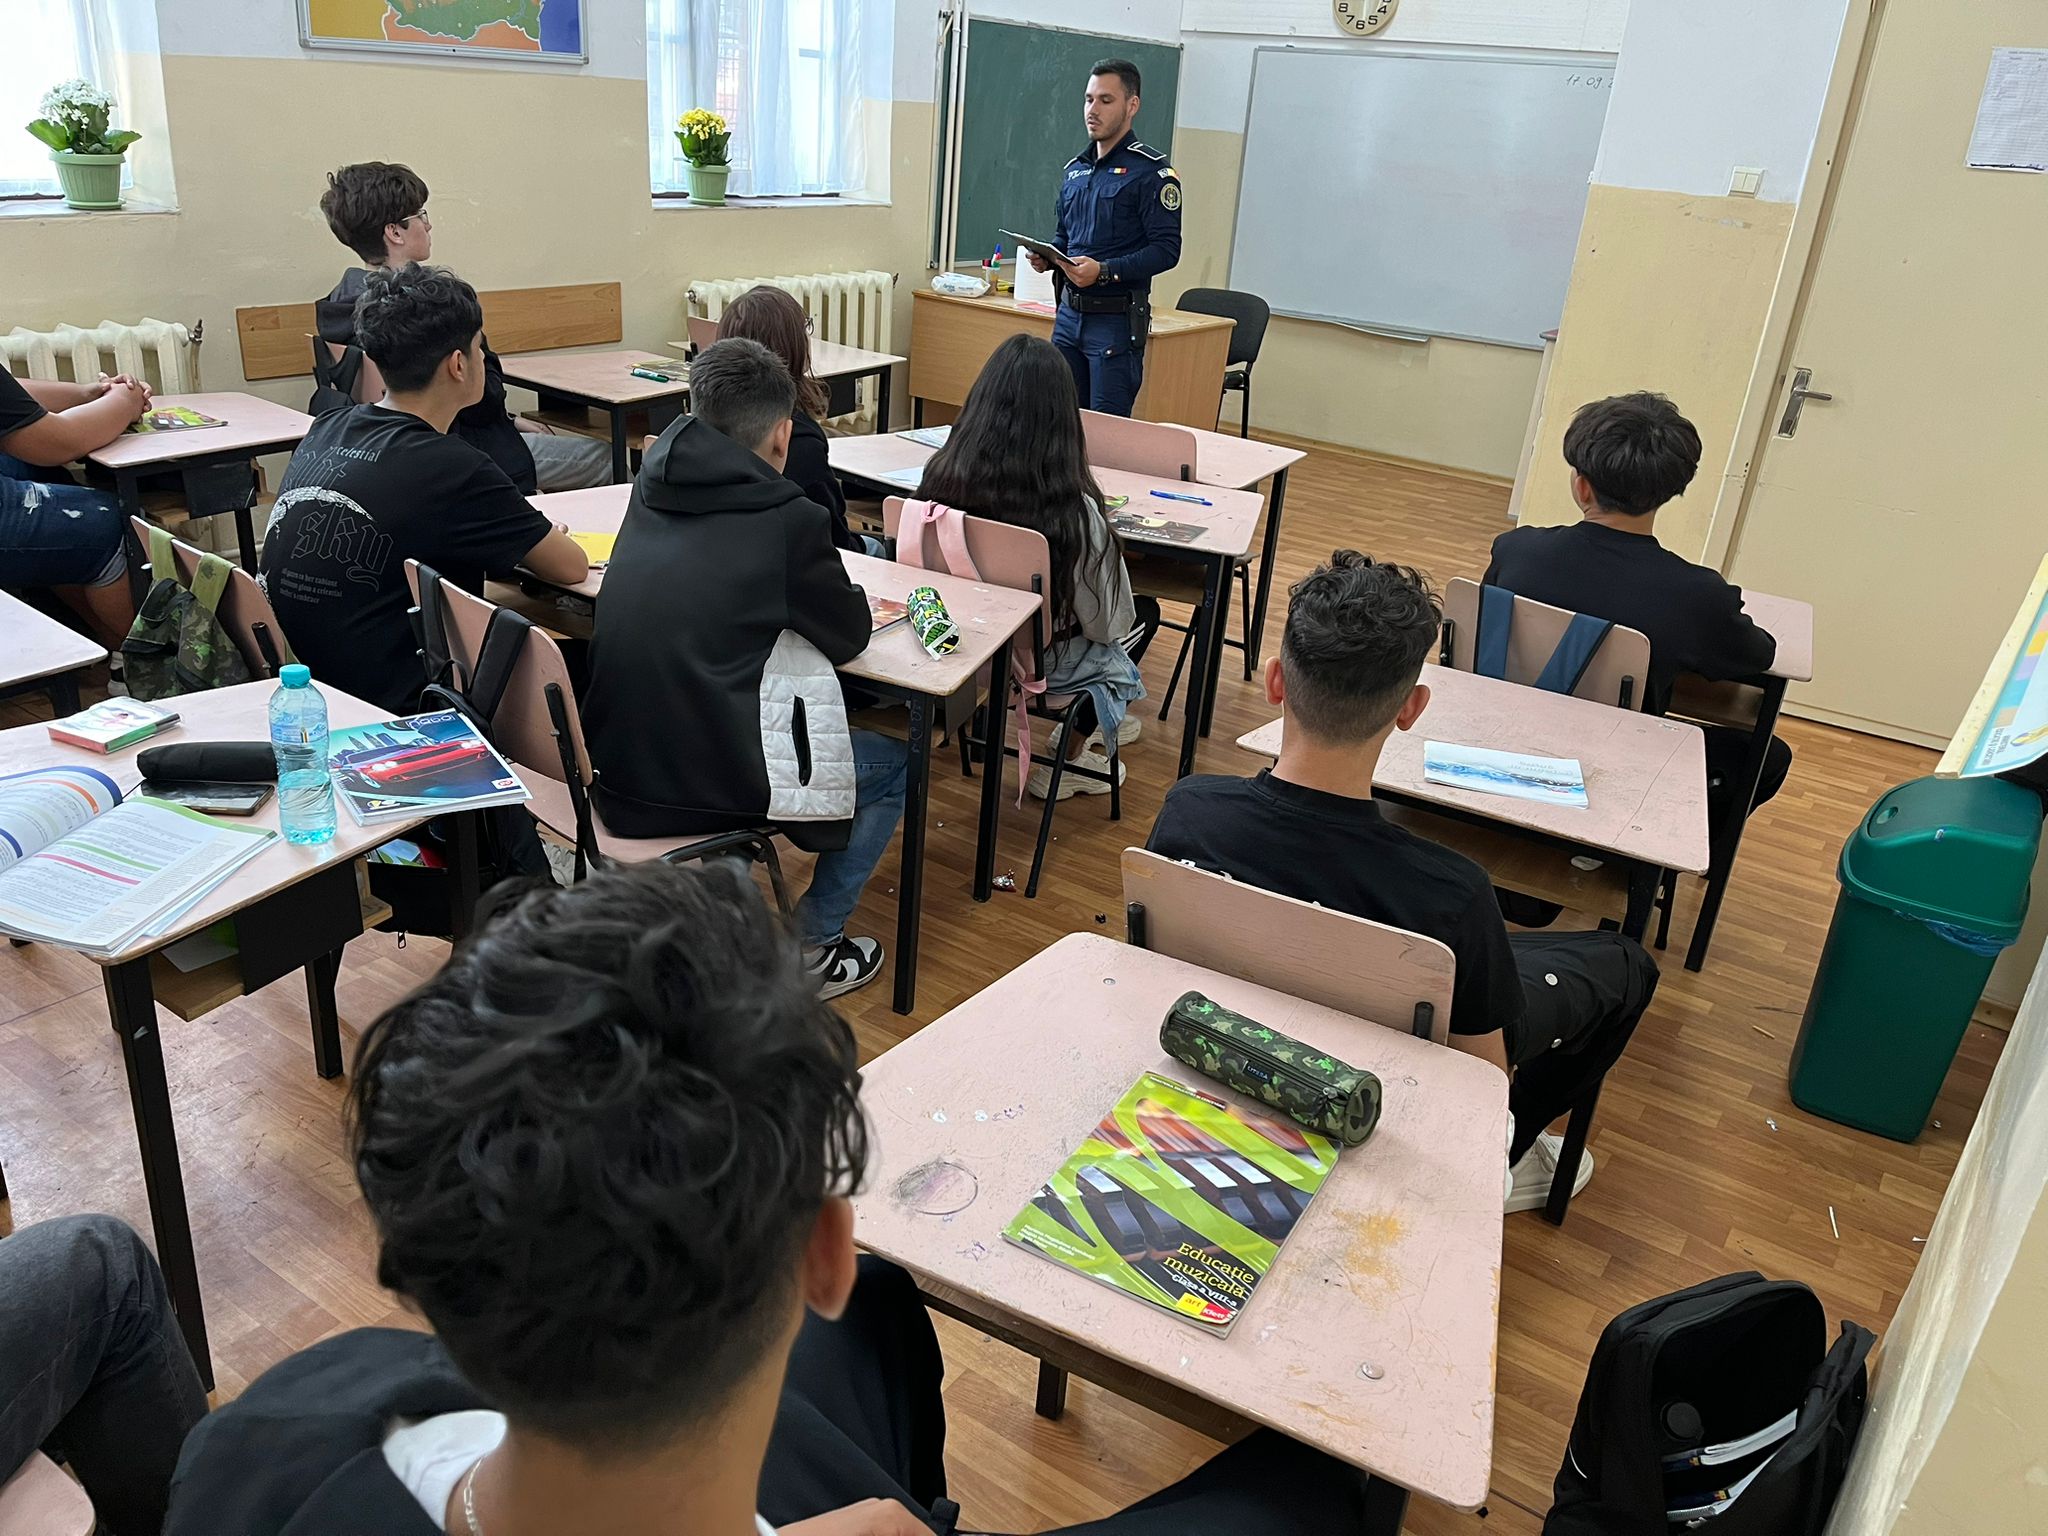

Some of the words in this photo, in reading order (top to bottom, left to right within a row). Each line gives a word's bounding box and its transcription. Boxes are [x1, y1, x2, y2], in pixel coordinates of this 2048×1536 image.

[1338, 3, 1348, 13] 8
[1377, 5, 1387, 15] 4
[1346, 15, 1355, 25] 7
[1355, 20, 1366, 30] 6
[1367, 15, 1378, 25] 5
[336, 446, 382, 463] celestial
[1185, 1298, 1202, 1307] art
